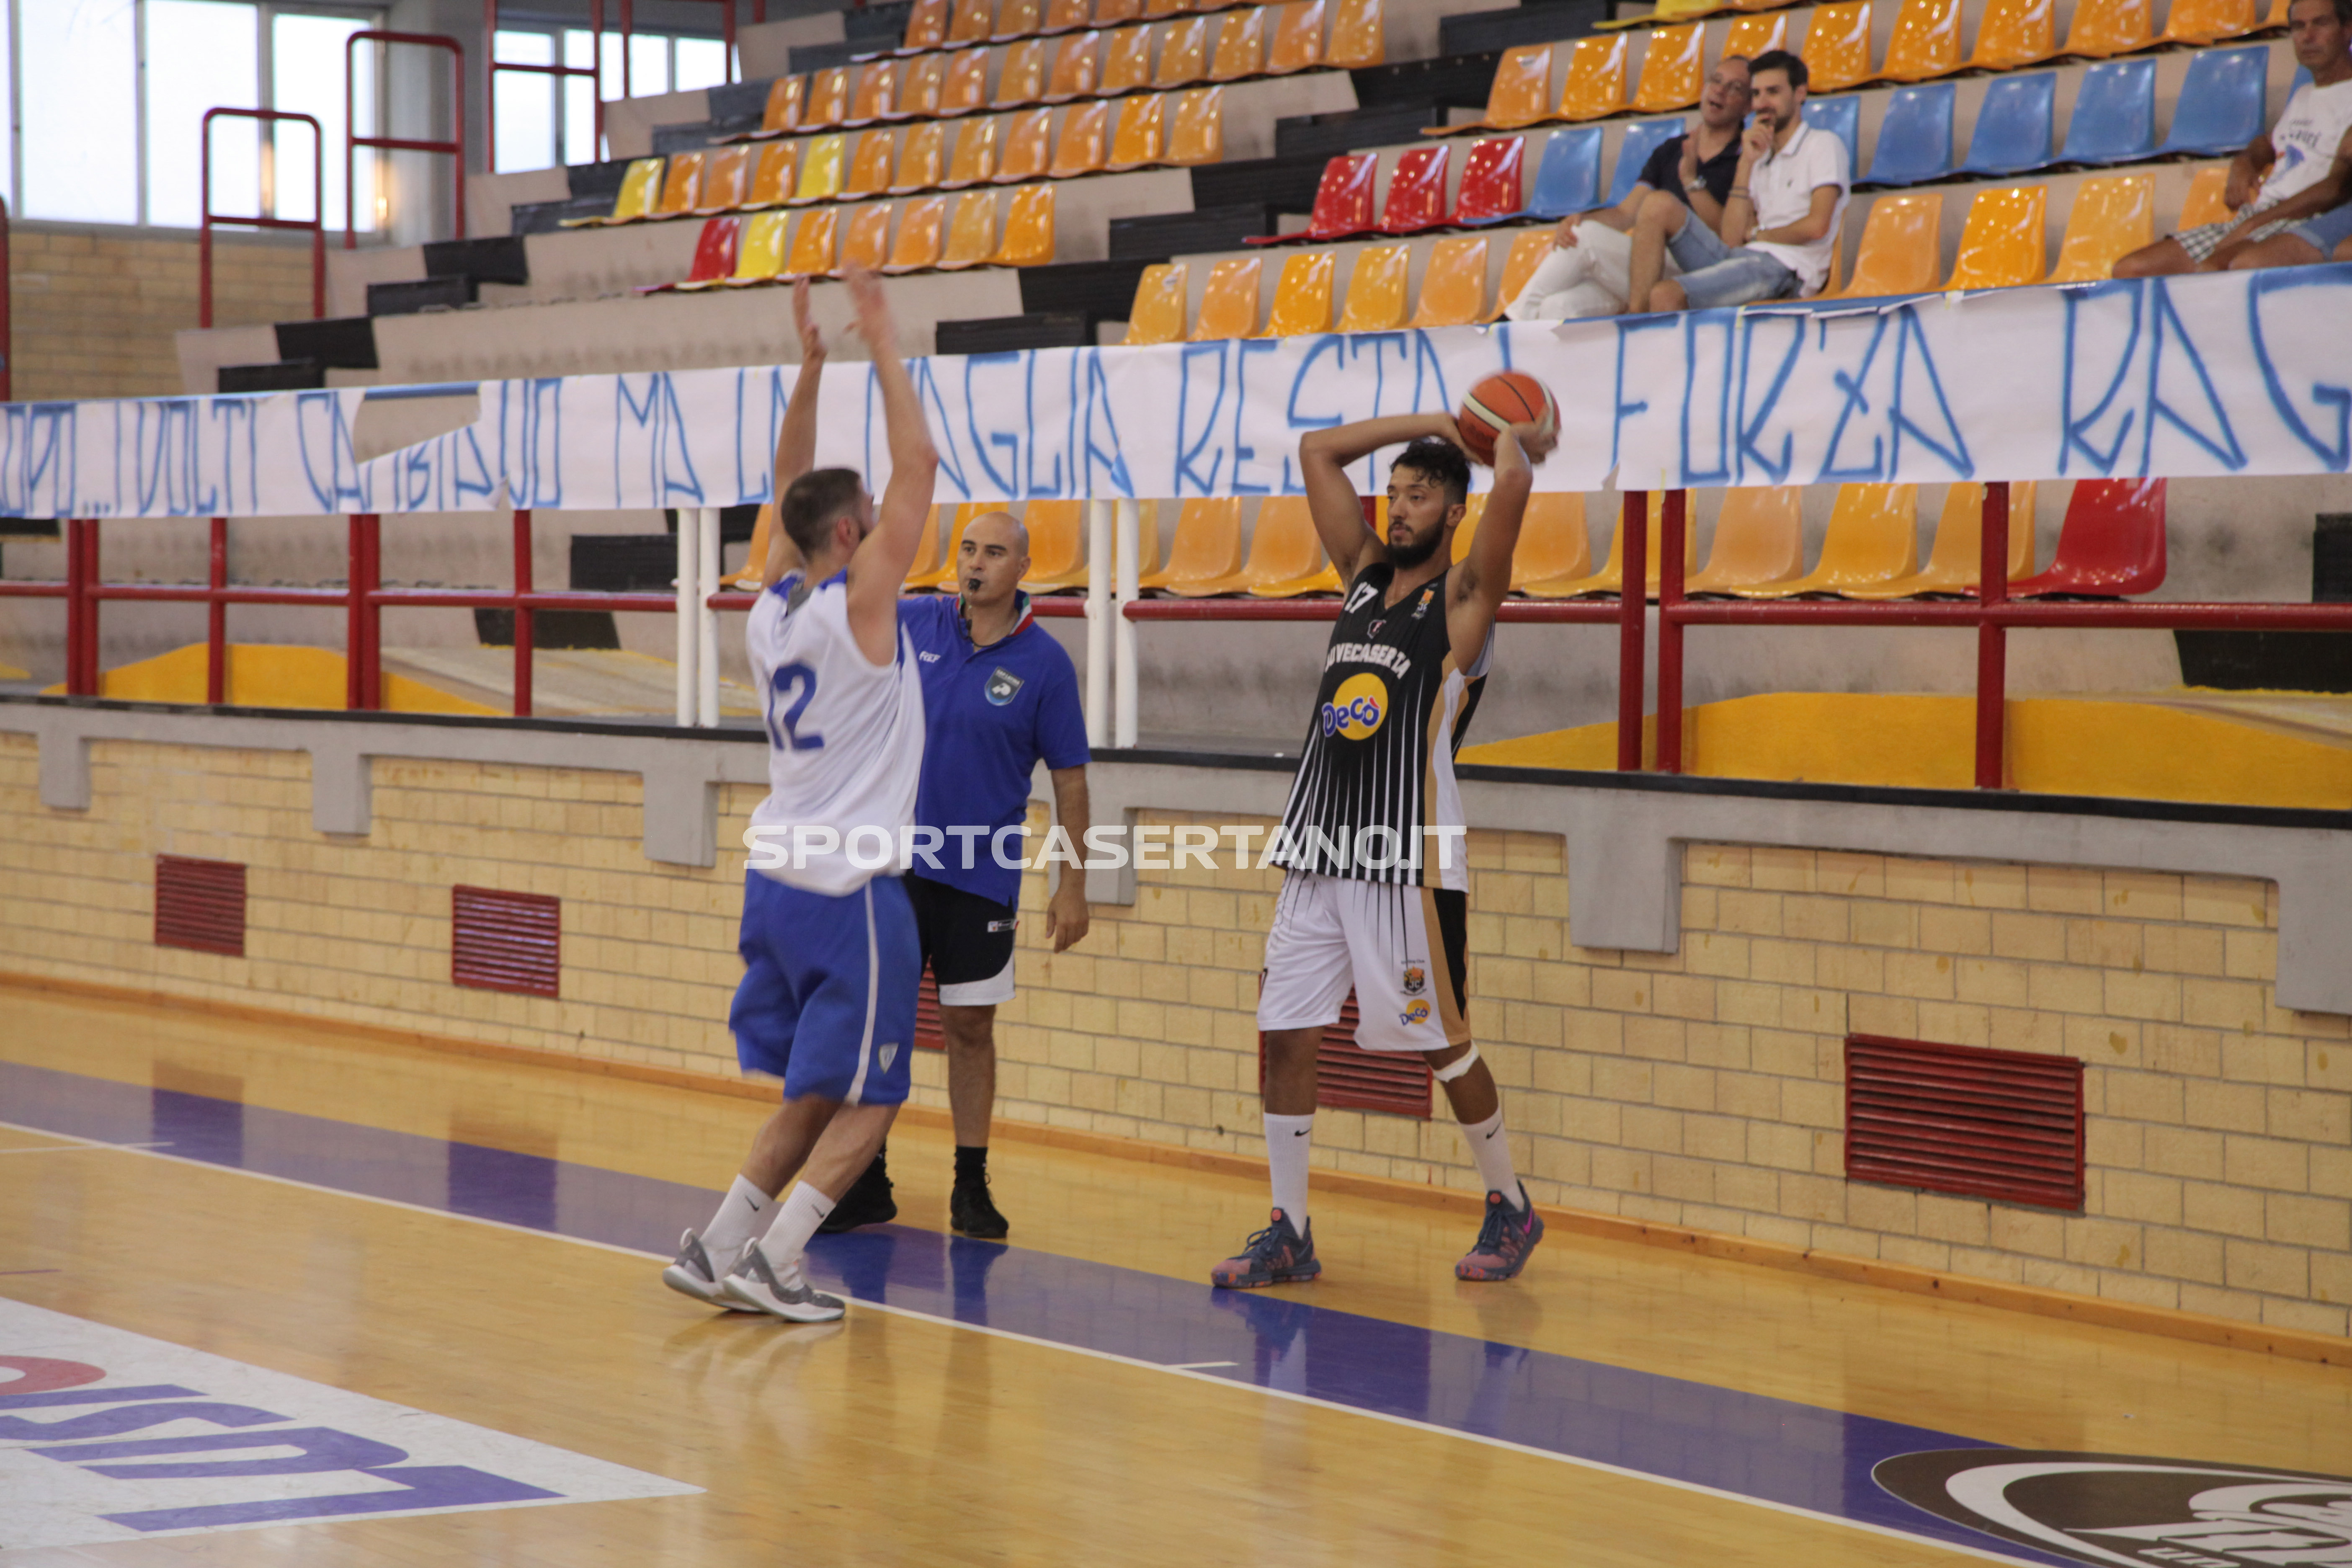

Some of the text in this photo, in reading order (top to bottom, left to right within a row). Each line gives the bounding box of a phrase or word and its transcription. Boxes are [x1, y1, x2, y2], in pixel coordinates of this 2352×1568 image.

[614, 371, 704, 509] MA
[1610, 303, 1975, 487] FORZA
[1344, 581, 1379, 614] 17
[1324, 642, 1411, 680] JUVECASERTA
